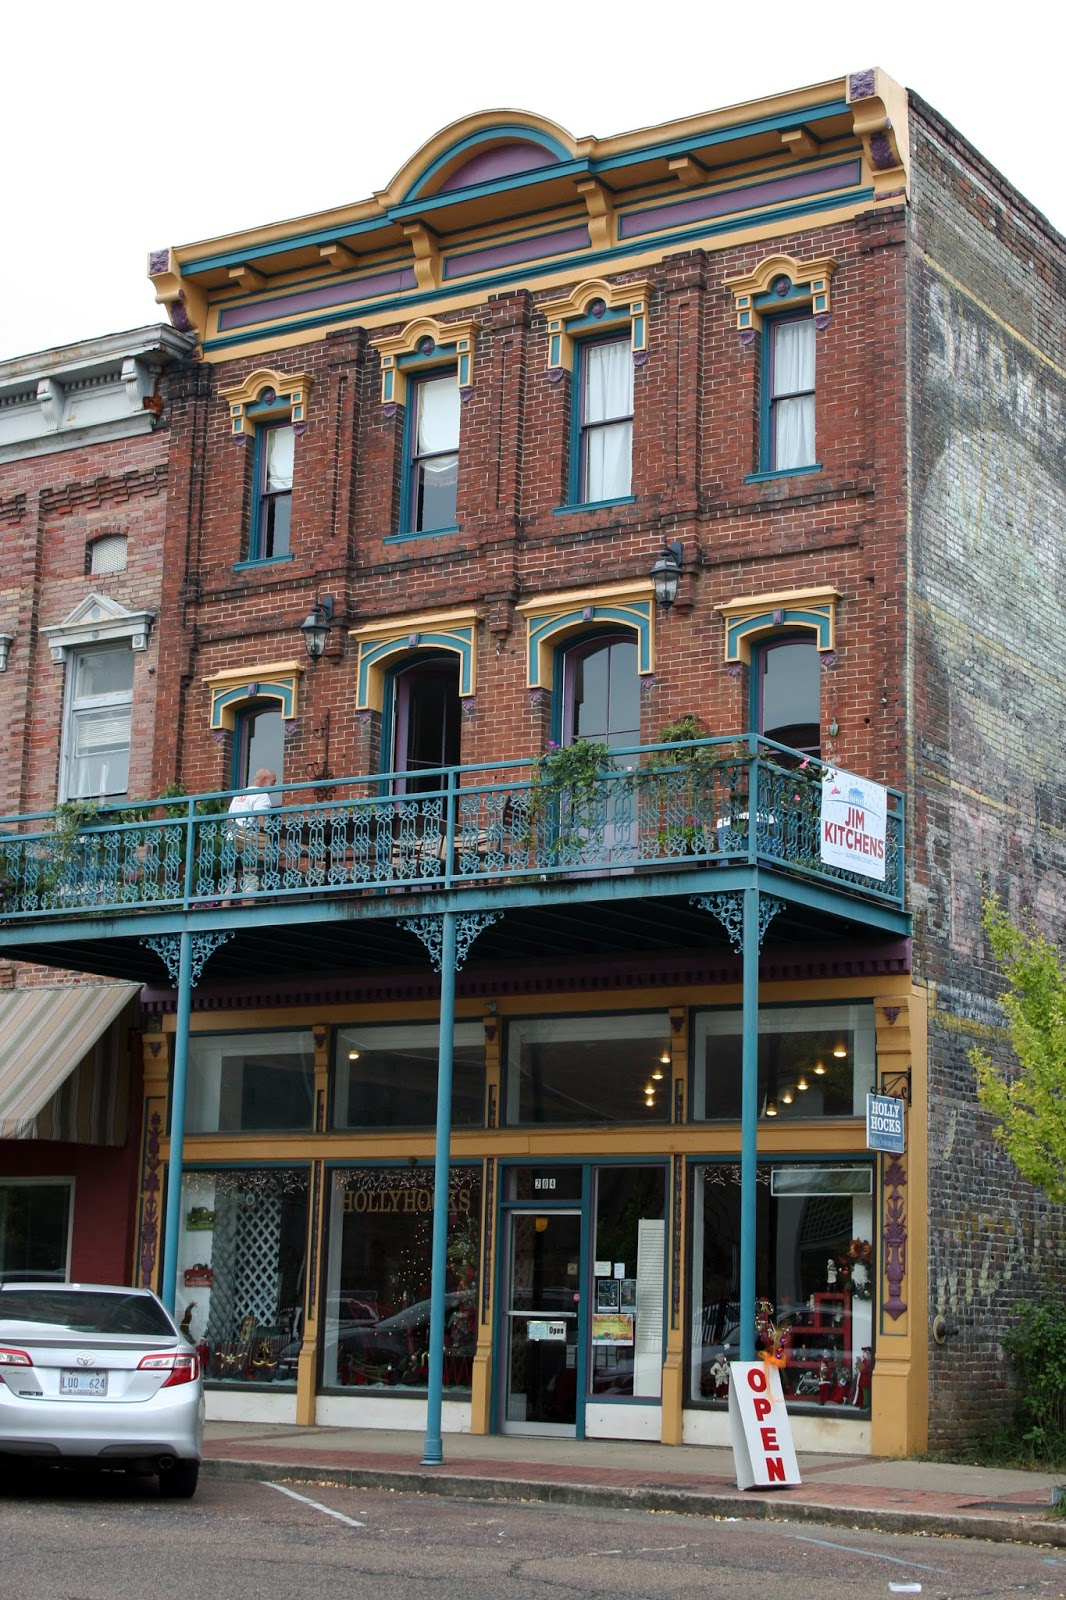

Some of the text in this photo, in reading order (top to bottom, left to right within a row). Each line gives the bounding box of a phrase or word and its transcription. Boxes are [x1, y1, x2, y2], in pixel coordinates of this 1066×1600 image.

[845, 807, 865, 831] JIM
[824, 822, 884, 859] KITCHENS
[871, 1101, 900, 1118] HOLLY
[871, 1116, 901, 1133] HOCKS
[535, 1178, 556, 1190] 204
[341, 1189, 471, 1212] HOLLYHOKS
[549, 1326, 564, 1336] Open
[88, 1378, 105, 1389] 624
[747, 1368, 786, 1482] OPEN
